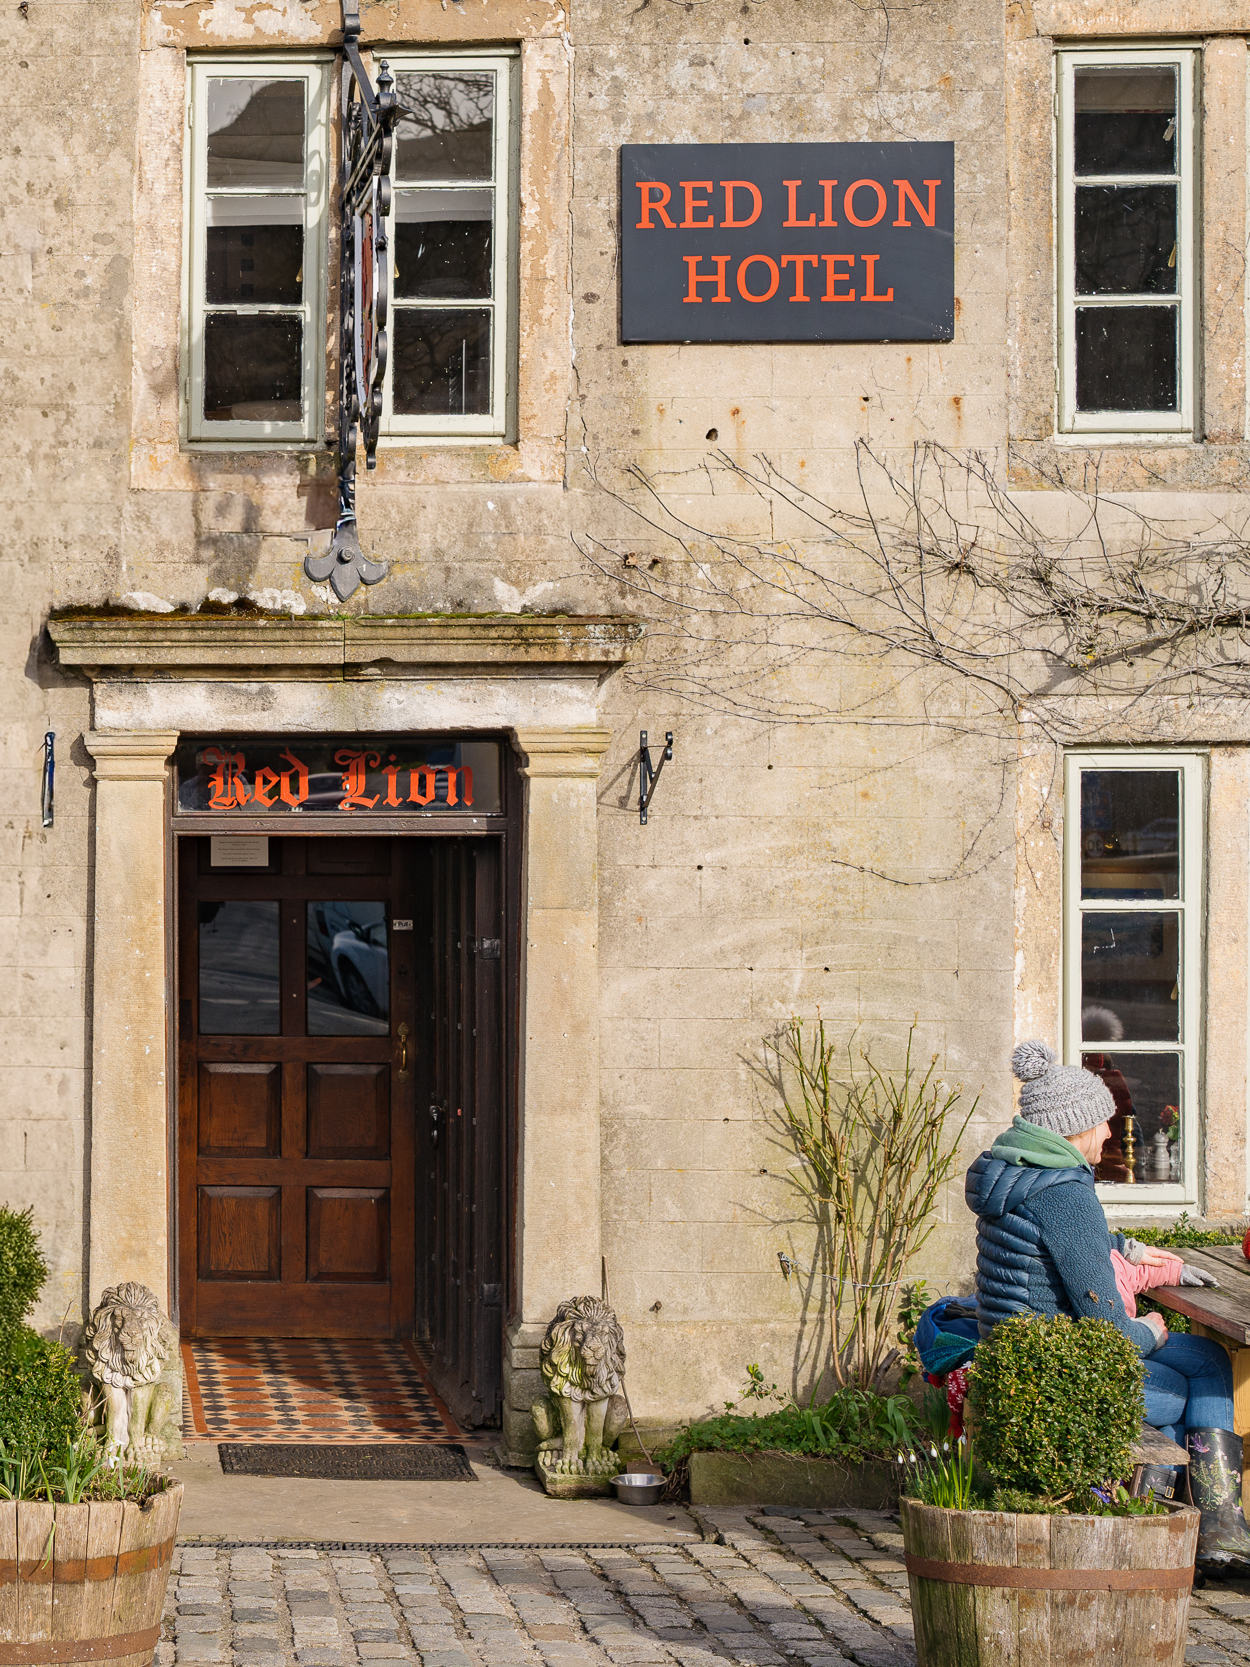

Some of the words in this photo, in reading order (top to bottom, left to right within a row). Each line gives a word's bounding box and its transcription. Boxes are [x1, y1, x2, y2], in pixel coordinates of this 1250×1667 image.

[635, 180, 763, 229] RED
[782, 178, 942, 228] LION
[682, 254, 894, 303] HOTEL
[202, 746, 309, 810] Red
[334, 749, 475, 811] Lion
